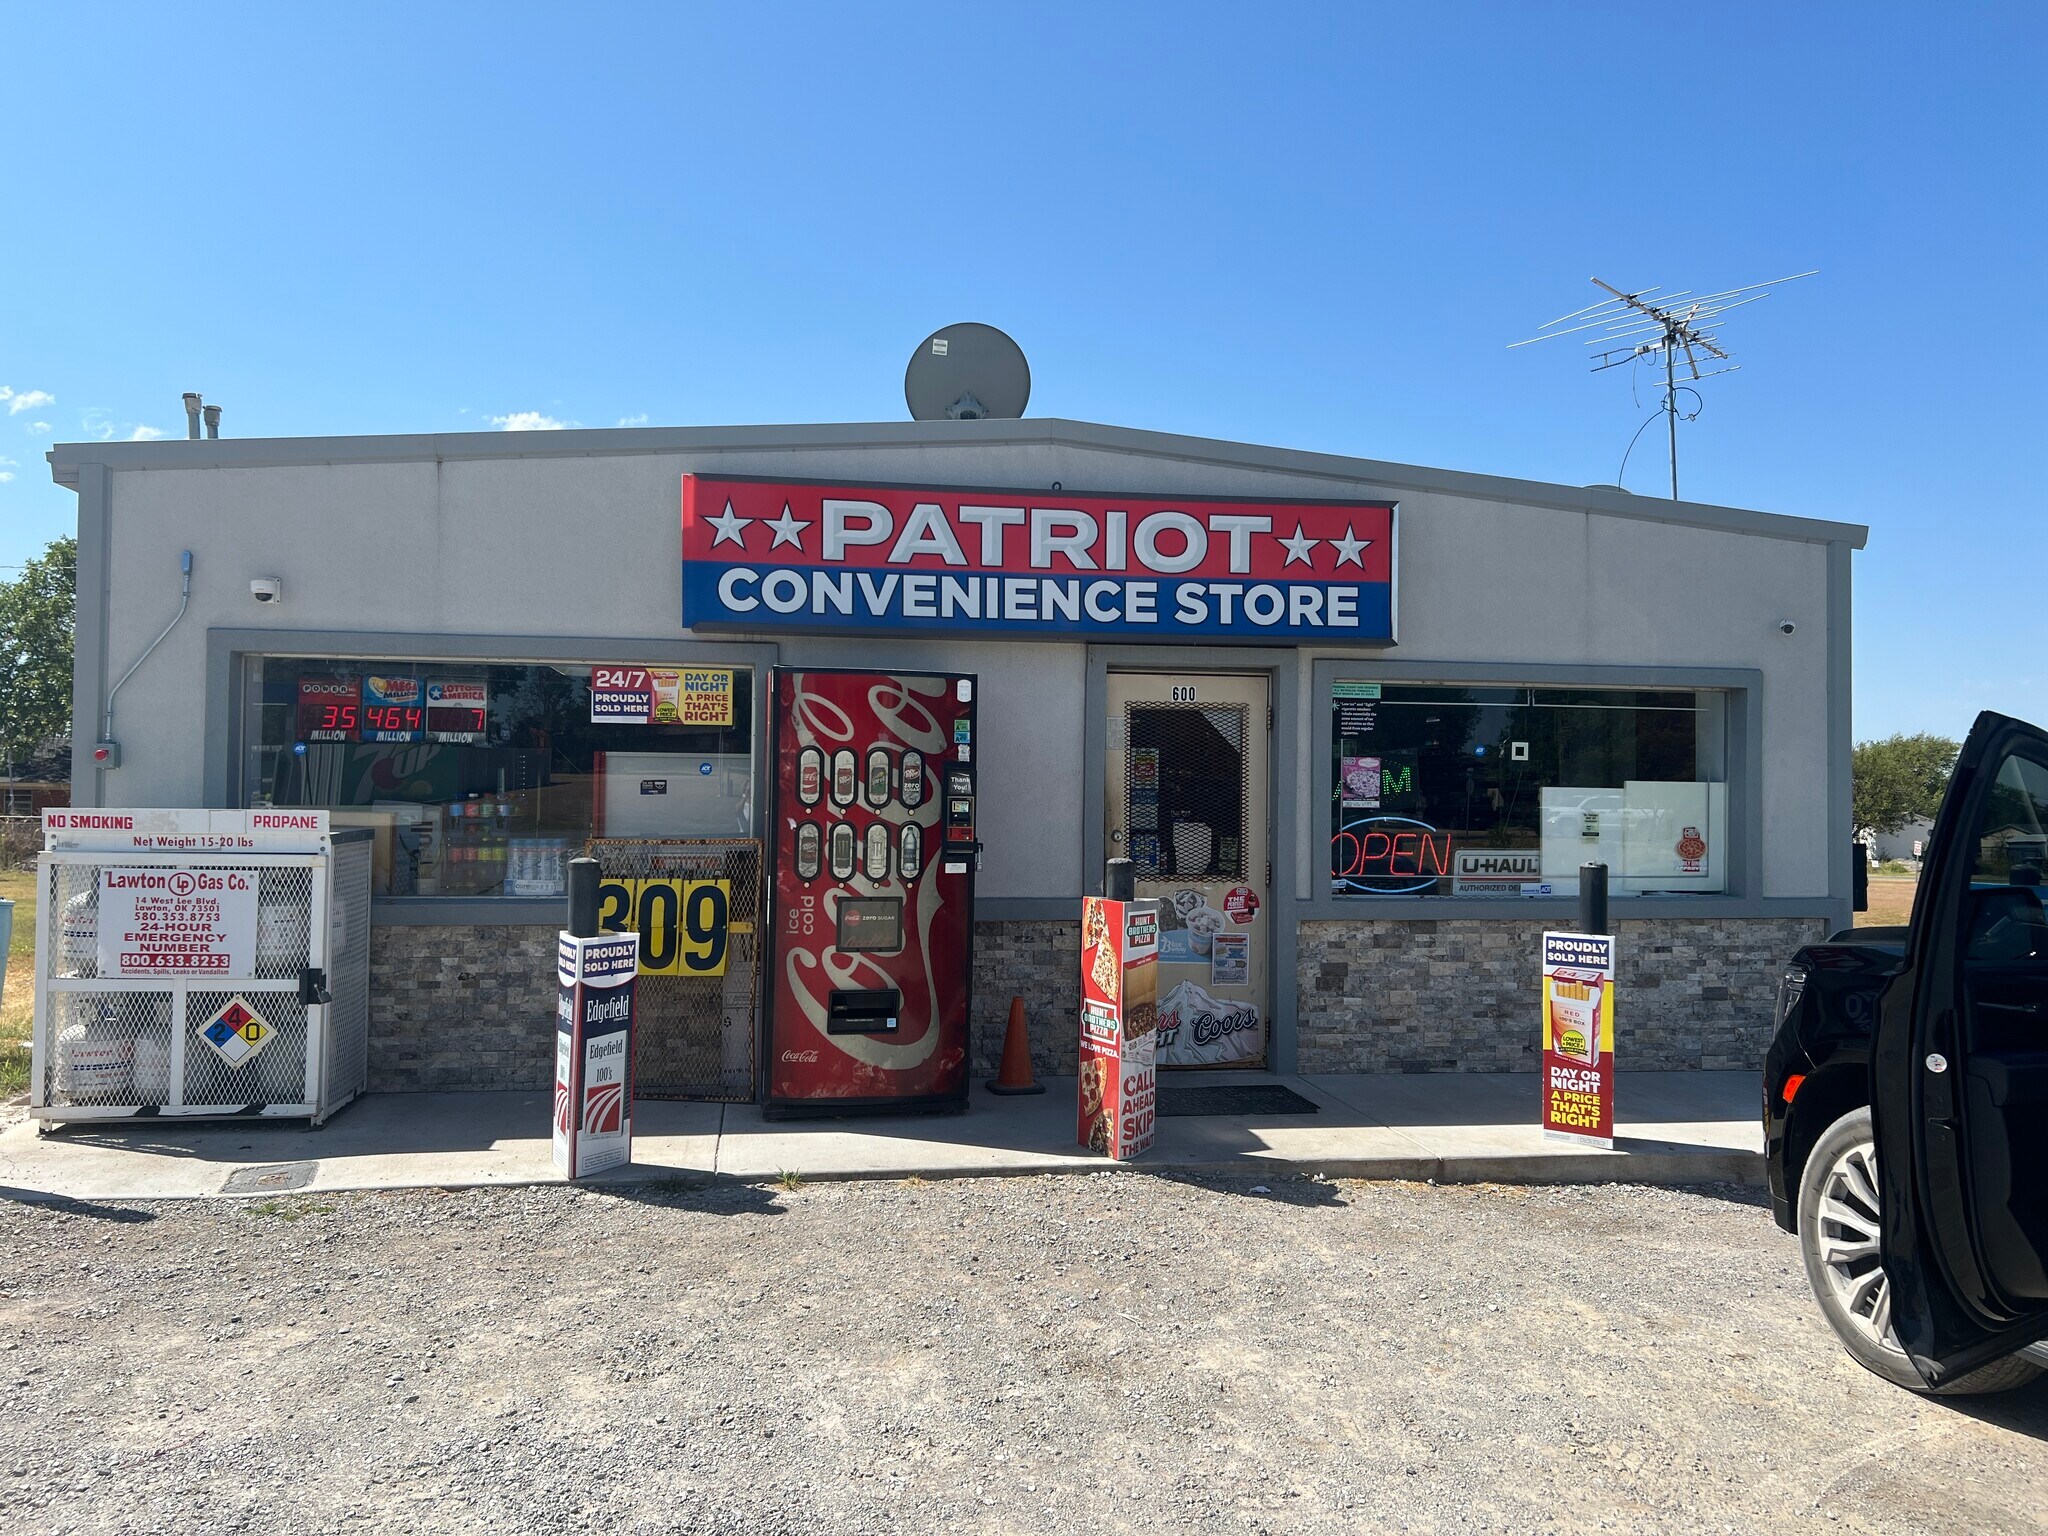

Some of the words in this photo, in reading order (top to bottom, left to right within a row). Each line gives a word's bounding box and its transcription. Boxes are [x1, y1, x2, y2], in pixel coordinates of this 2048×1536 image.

[821, 497, 1273, 575] PATRIOT
[717, 567, 1158, 624] CONVENIENCE
[1174, 582, 1360, 628] STORE
[596, 670, 646, 689] 24/7
[685, 673, 708, 682] DAY
[711, 673, 729, 682] OR
[385, 679, 418, 692] MEGA
[442, 684, 472, 692] LOTTO
[685, 682, 729, 692] NIGHT
[441, 691, 485, 701] AMERICA
[595, 693, 649, 703] PROUDLY
[696, 694, 728, 702] PRICE
[1173, 686, 1195, 701] 600
[594, 704, 621, 712] SOLD
[623, 704, 649, 713] HERE
[685, 702, 728, 711] THAT'S
[322, 706, 356, 728] 35
[367, 707, 421, 729] 464
[471, 709, 485, 730] 7
[685, 711, 728, 721] RIGHT
[310, 730, 346, 741] MILLION
[376, 731, 411, 742] MILLION
[438, 732, 473, 743] MILLION
[47, 815, 66, 828] NO
[70, 815, 133, 830] SMOKING
[253, 815, 318, 829] PROPANE
[133, 836, 153, 847] Net
[157, 836, 196, 849] Weight
[200, 836, 234, 848] 15-20
[237, 836, 254, 848] lbs
[1332, 833, 1450, 876] OPEN
[1463, 858, 1537, 873] U-HAUL
[107, 871, 166, 889] Lawton
[198, 872, 224, 890] Gas
[228, 873, 249, 891] Co.
[1459, 884, 1505, 892] AUTHORIZED
[135, 896, 147, 904] 14
[151, 896, 173, 905] West
[177, 897, 192, 905] Lee
[196, 897, 220, 905] Blvd.
[174, 904, 188, 912] OK
[801, 895, 815, 935] cold
[134, 912, 221, 922] 580.353.8753
[786, 908, 799, 934] ice
[1135, 915, 1151, 926] HUNT
[140, 922, 212, 932] 24-HOUR
[599, 884, 729, 971] 309
[1128, 923, 1156, 935] BROTHERS
[124, 933, 227, 942] EMERGENCY
[1134, 934, 1151, 944] PIZZA
[139, 943, 210, 953] NUMBER
[585, 944, 635, 961] PROUDLY
[1548, 940, 1608, 954] PROUDLY
[121, 954, 229, 967] 800.633.8253
[1547, 952, 1576, 962] SOLD
[1578, 955, 1608, 965] HERE
[584, 960, 610, 973] SOLD
[611, 959, 634, 970] HERE
[1556, 970, 1596, 980] 24/7
[586, 994, 630, 1024] Edgefield
[1090, 1005, 1108, 1018] HUNT
[1564, 1009, 1580, 1018] RED
[228, 1007, 242, 1027] 4
[1084, 1013, 1116, 1030] BROTHERS
[213, 1023, 225, 1043] 2
[245, 1022, 260, 1041] 0
[1089, 1023, 1109, 1037] PIZZA
[1190, 1007, 1256, 1046] Coors
[589, 1039, 623, 1060] Edgefield
[1080, 1040, 1088, 1049] WE
[1088, 1043, 1101, 1054] LOVE
[596, 1066, 613, 1082] 100's
[1551, 1066, 1579, 1079] DAY
[1580, 1070, 1601, 1082] OR
[1123, 1069, 1155, 1097] CALL
[1551, 1077, 1601, 1093] NIGHT
[1122, 1091, 1155, 1115] AHEAD
[1551, 1090, 1561, 1100] A
[1563, 1092, 1600, 1105] PRICE
[1551, 1100, 1600, 1117] THAT'S
[1123, 1109, 1154, 1141] SKIP
[1551, 1111, 1601, 1129] RIGHT
[1121, 1143, 1139, 1157] THE
[1139, 1134, 1155, 1150] WAIT
